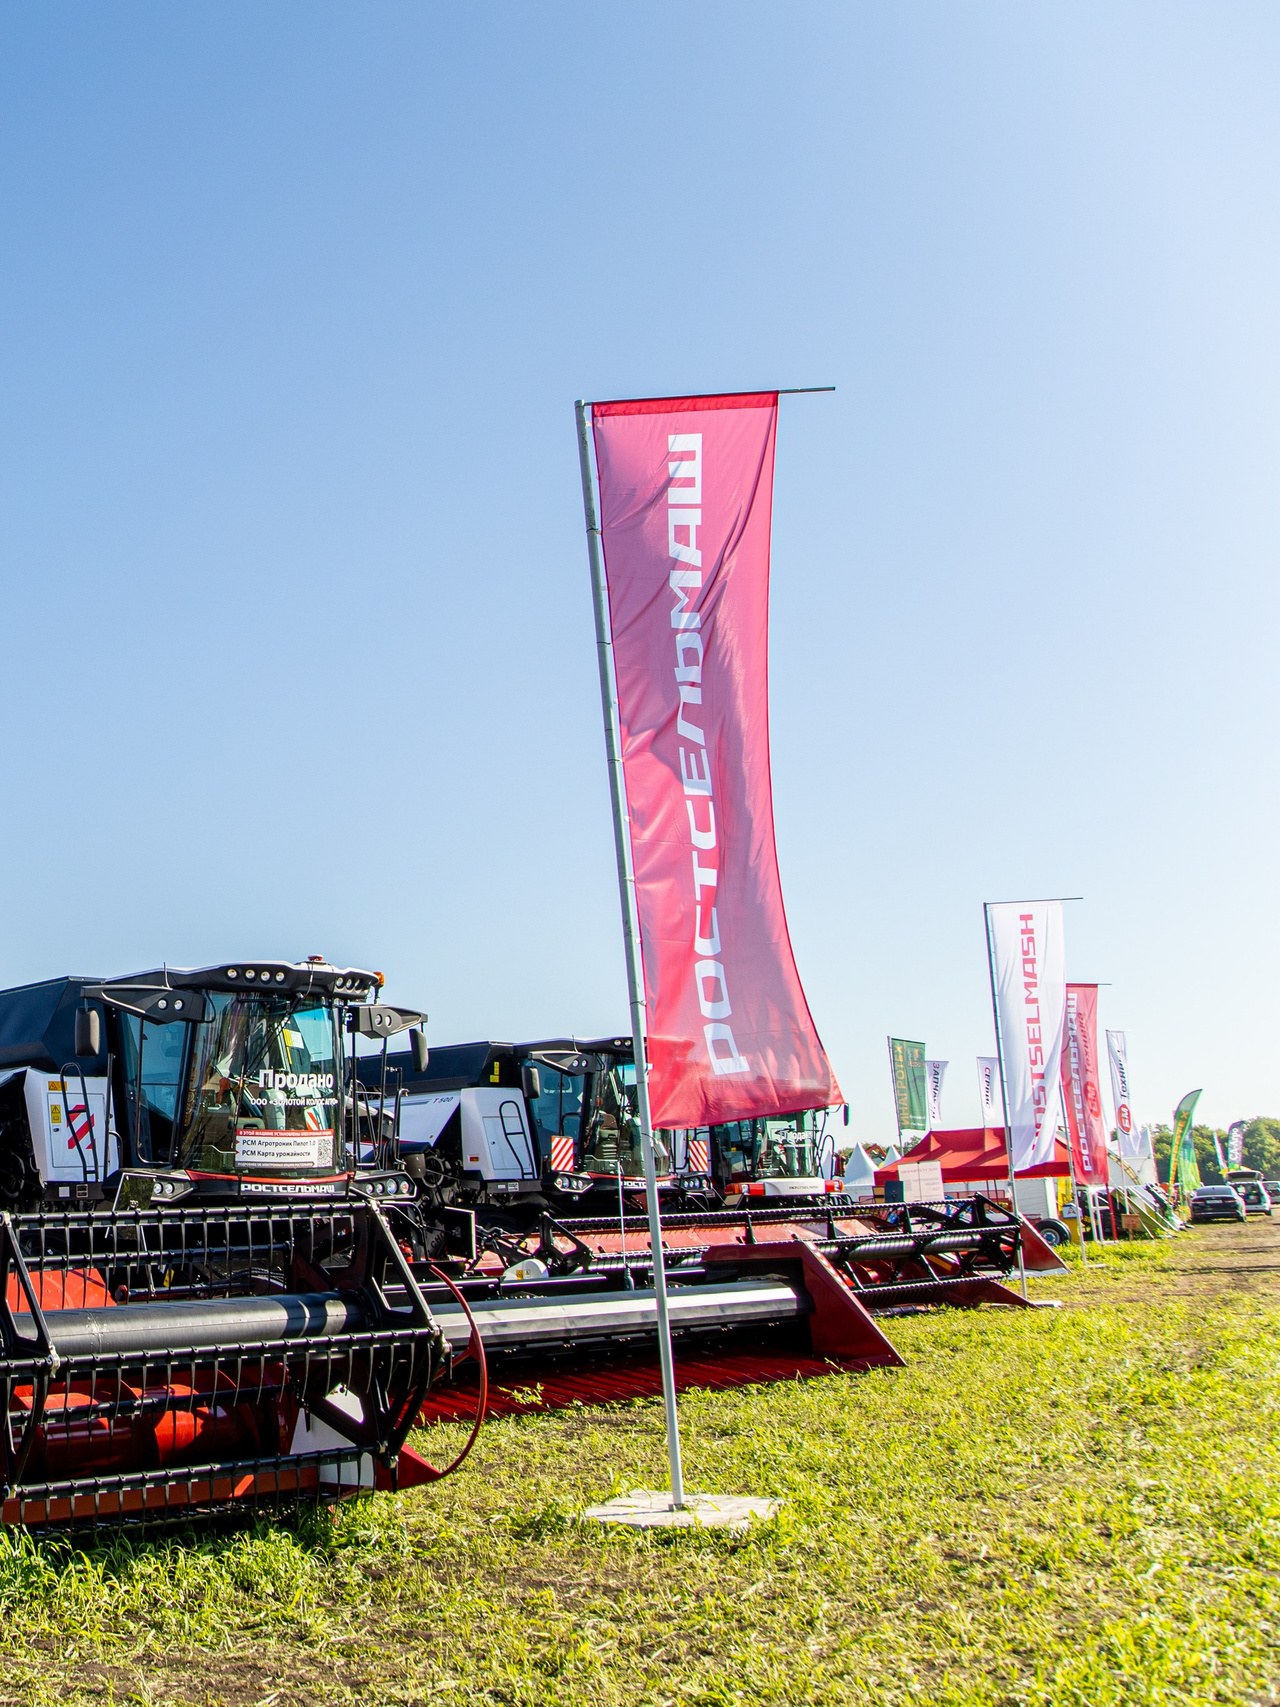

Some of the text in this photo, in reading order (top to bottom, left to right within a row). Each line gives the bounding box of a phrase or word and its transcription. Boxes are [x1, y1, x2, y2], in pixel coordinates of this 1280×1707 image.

[667, 433, 749, 1077] РОСТСЕЛЬМАШ
[258, 1069, 335, 1091] Продано
[1066, 992, 1093, 1172] РОСТСЕЛЬМАШ
[258, 1140, 292, 1148] Агротроник
[257, 1150, 274, 1158] Карта
[240, 1183, 335, 1194] РОСТСЕЛЬМАШ
